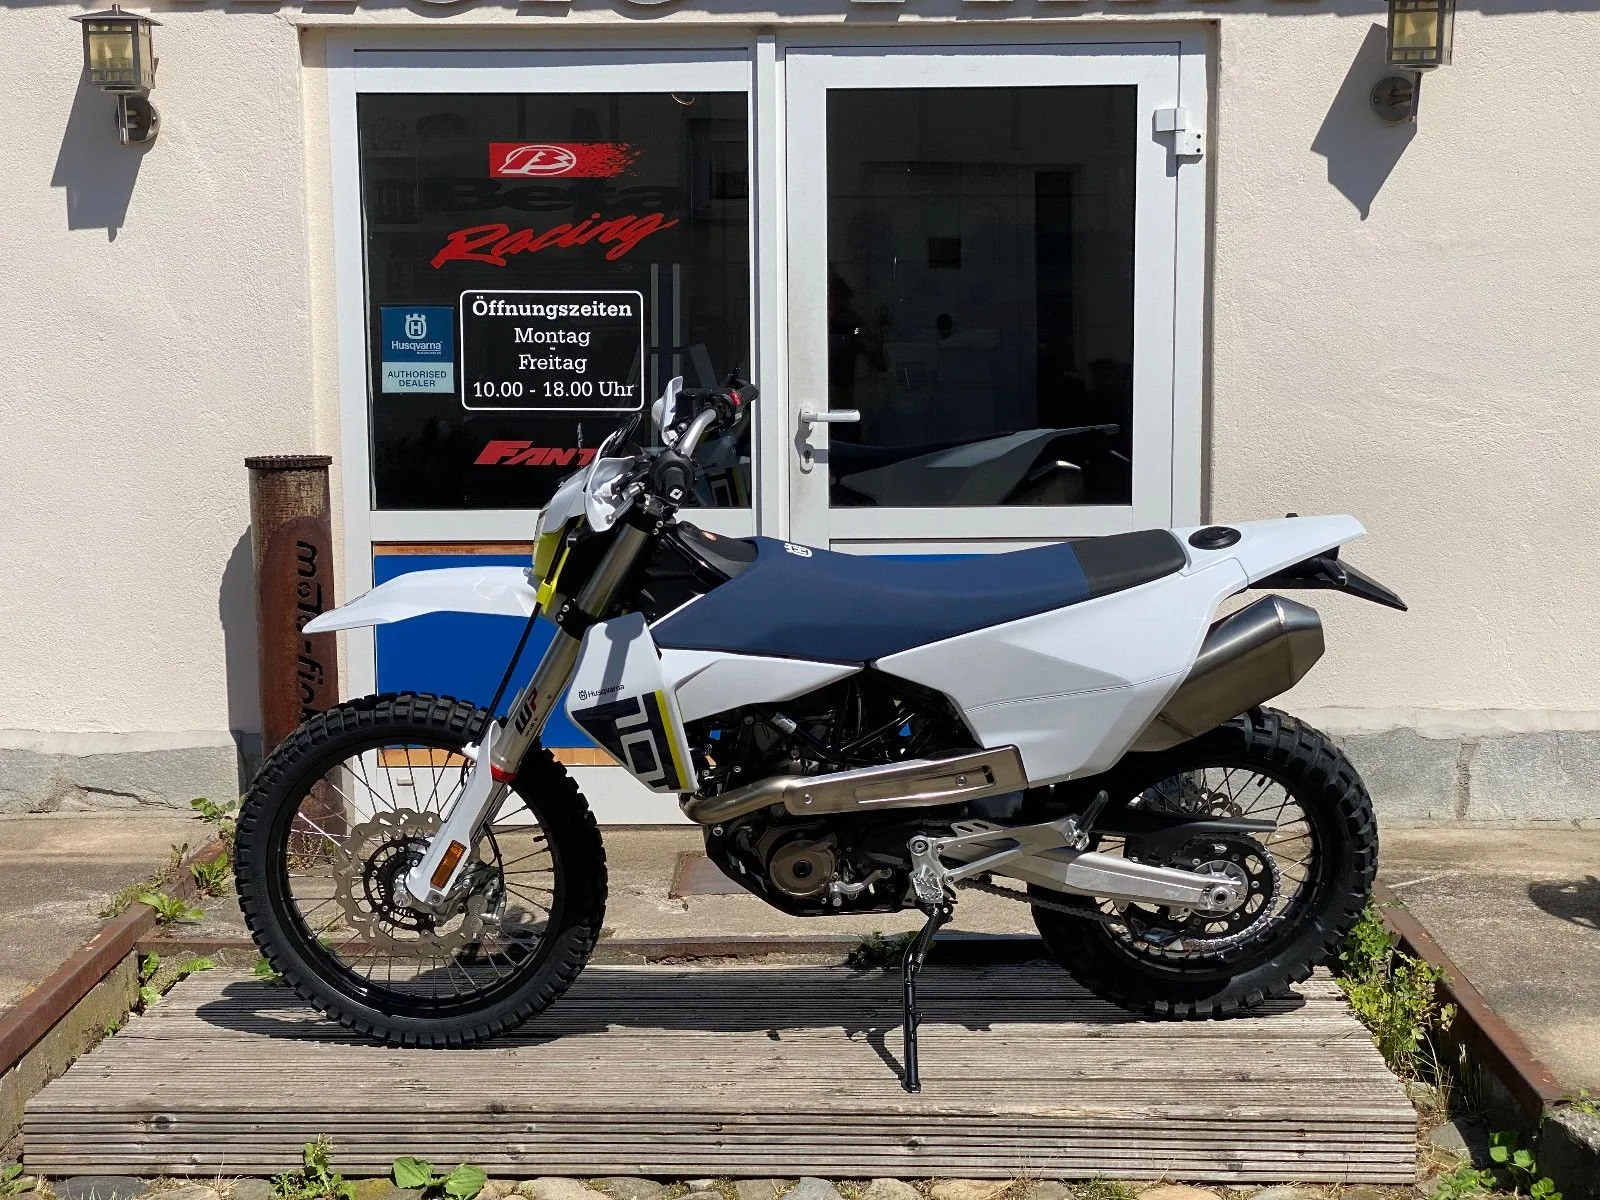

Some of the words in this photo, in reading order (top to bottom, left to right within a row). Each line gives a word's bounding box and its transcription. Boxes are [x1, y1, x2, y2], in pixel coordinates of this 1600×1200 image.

[431, 213, 680, 269] Racing
[472, 295, 633, 320] Öffnungszeiten
[391, 340, 443, 352] Husqvarna
[514, 327, 591, 347] Montag
[518, 354, 588, 374] Freitag
[387, 370, 447, 379] AUTHORISED
[473, 381, 524, 398] 10.00
[543, 381, 593, 398] 18.00
[598, 381, 635, 397] Uhr
[588, 684, 625, 698] Husqvarna
